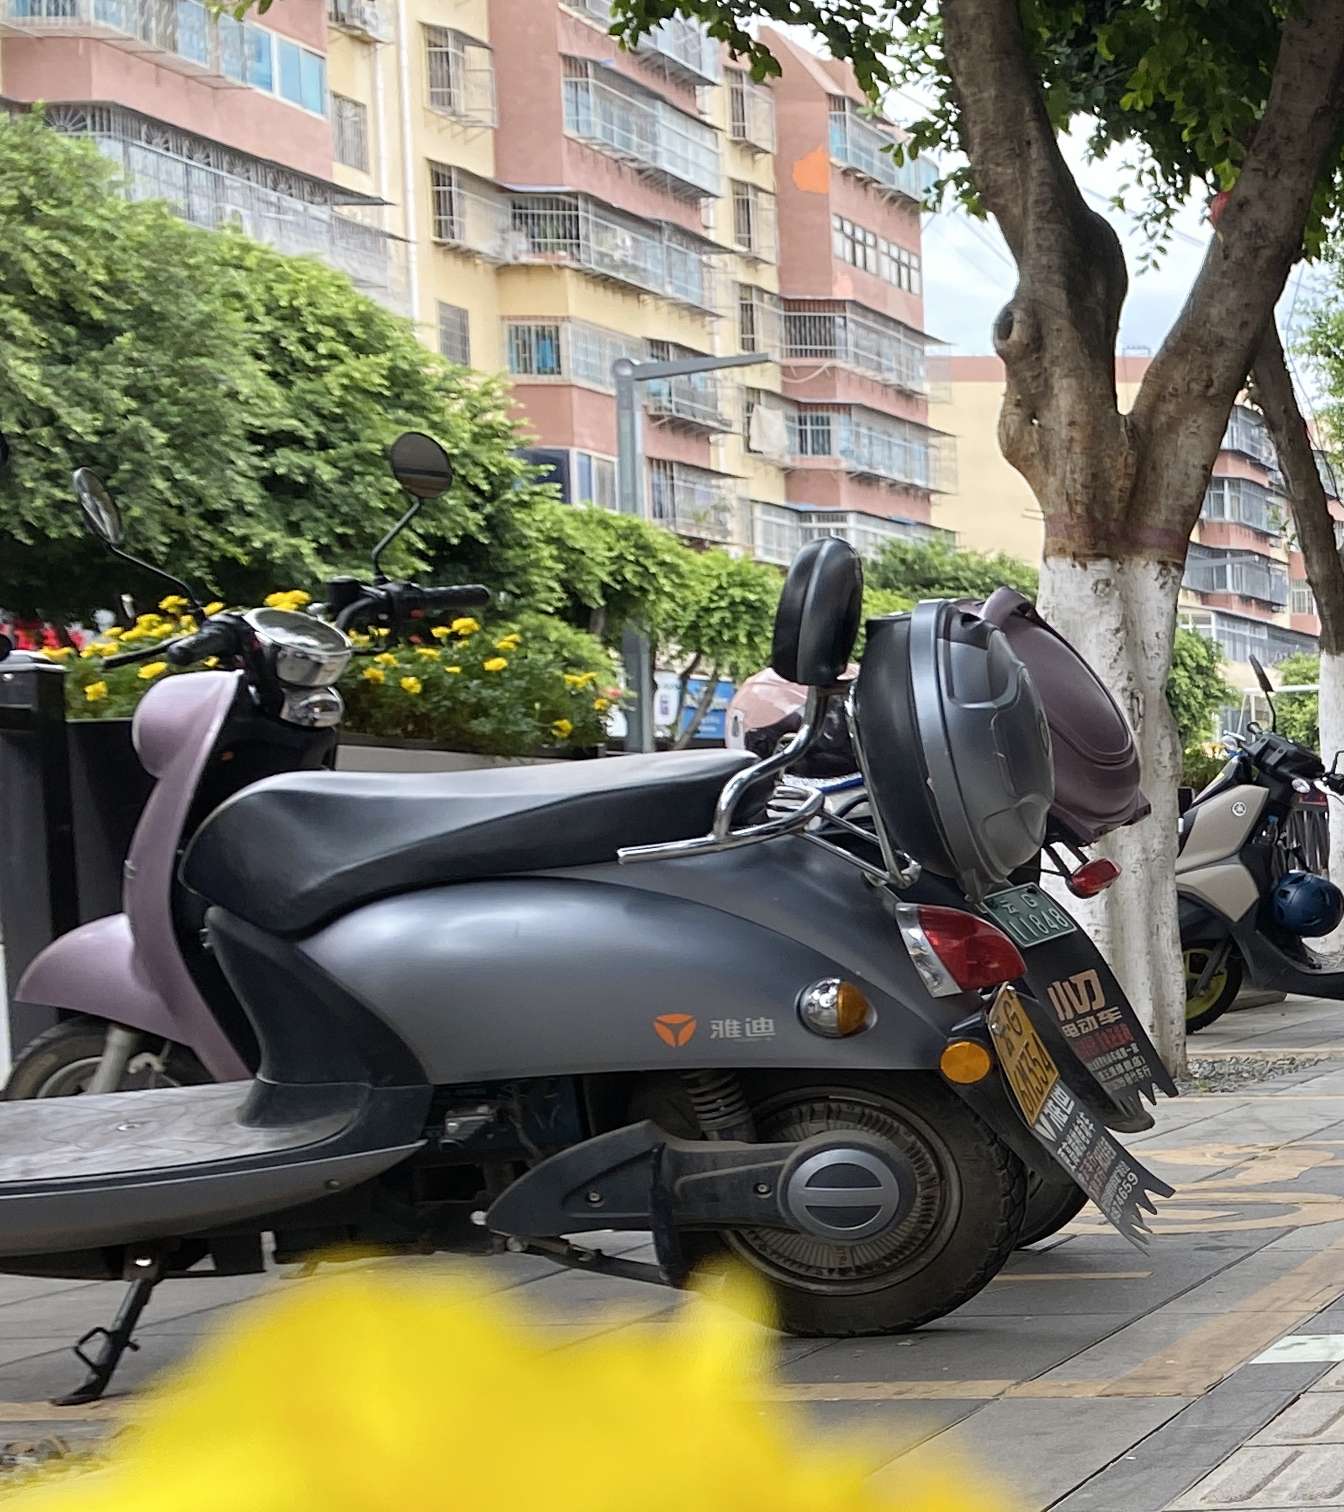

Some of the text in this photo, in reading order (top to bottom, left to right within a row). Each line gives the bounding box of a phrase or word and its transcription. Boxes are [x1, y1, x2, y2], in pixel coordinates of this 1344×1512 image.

[1008, 908, 1069, 940] 11848
[709, 1017, 776, 1039] 雅迪
[1061, 1006, 1123, 1038] 电动车
